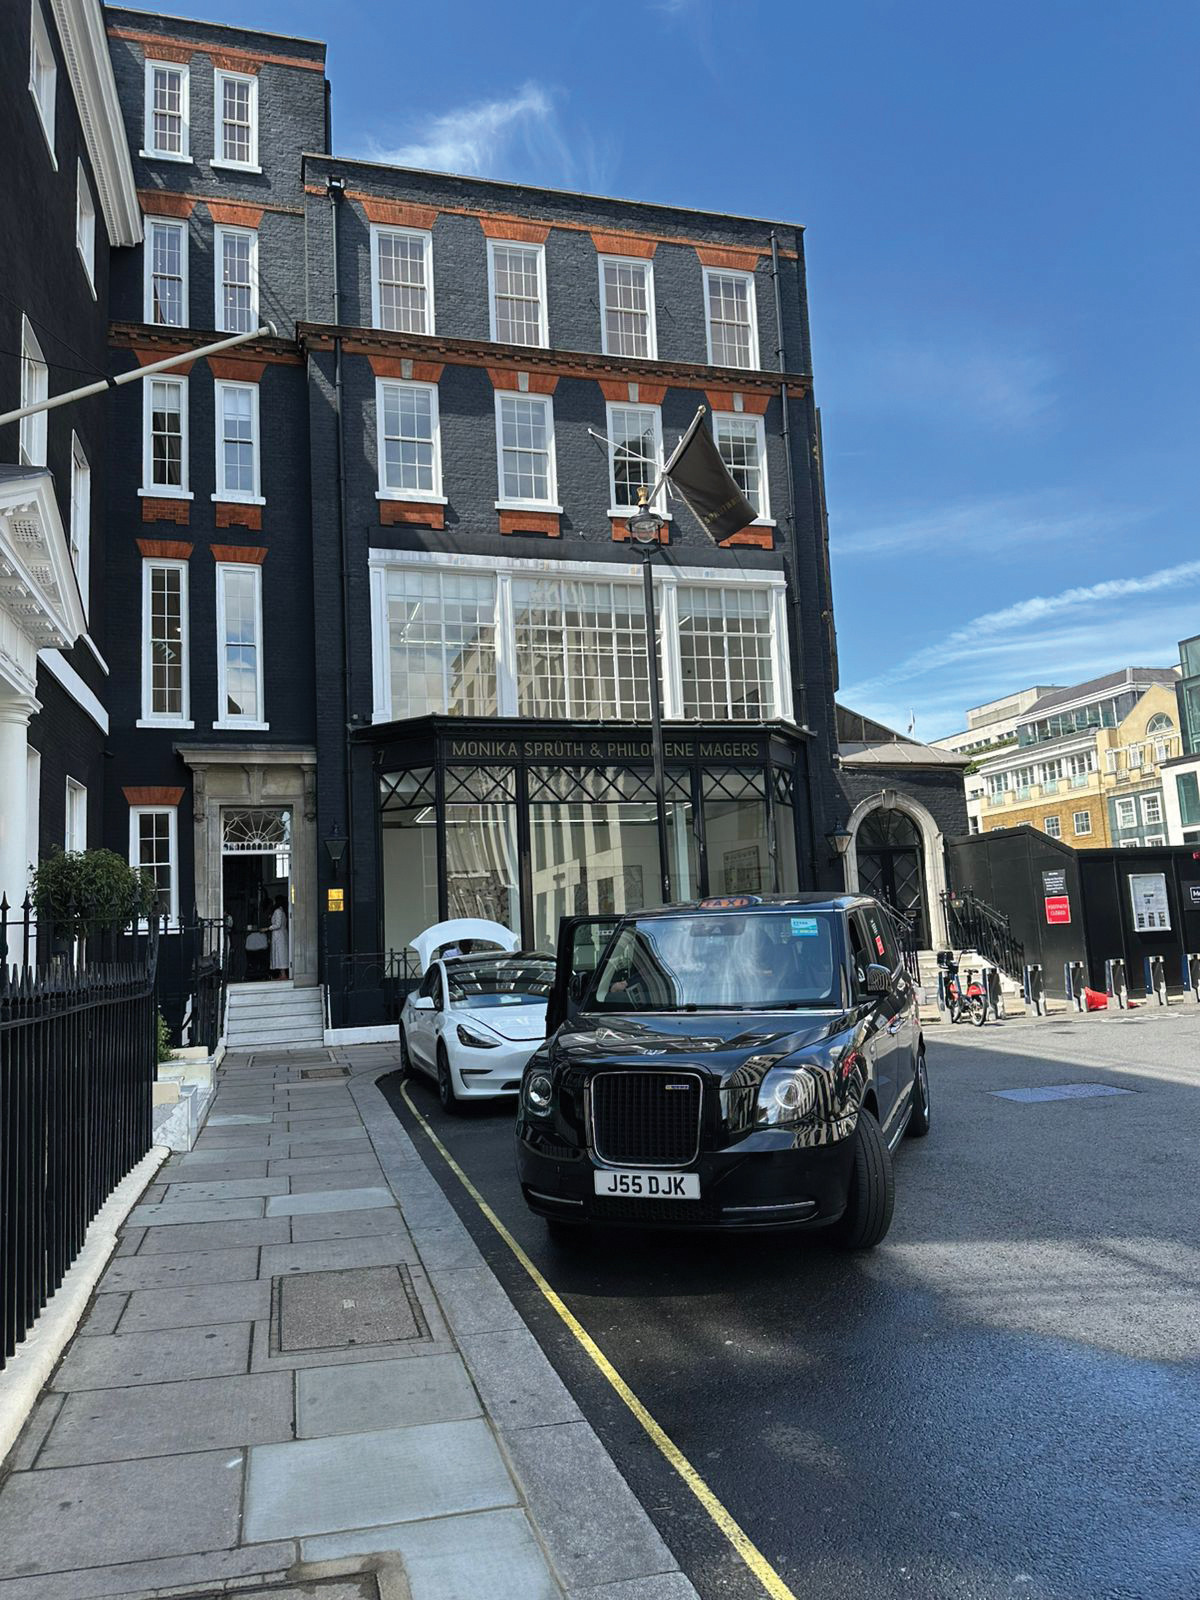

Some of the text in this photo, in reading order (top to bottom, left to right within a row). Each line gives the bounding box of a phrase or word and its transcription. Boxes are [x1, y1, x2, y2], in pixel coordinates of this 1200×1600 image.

[452, 741, 760, 758] MONIKA SPRÜTH & PHILOENE MAGERS
[703, 898, 745, 909] TAXI
[608, 1174, 686, 1195] J55 DJK
